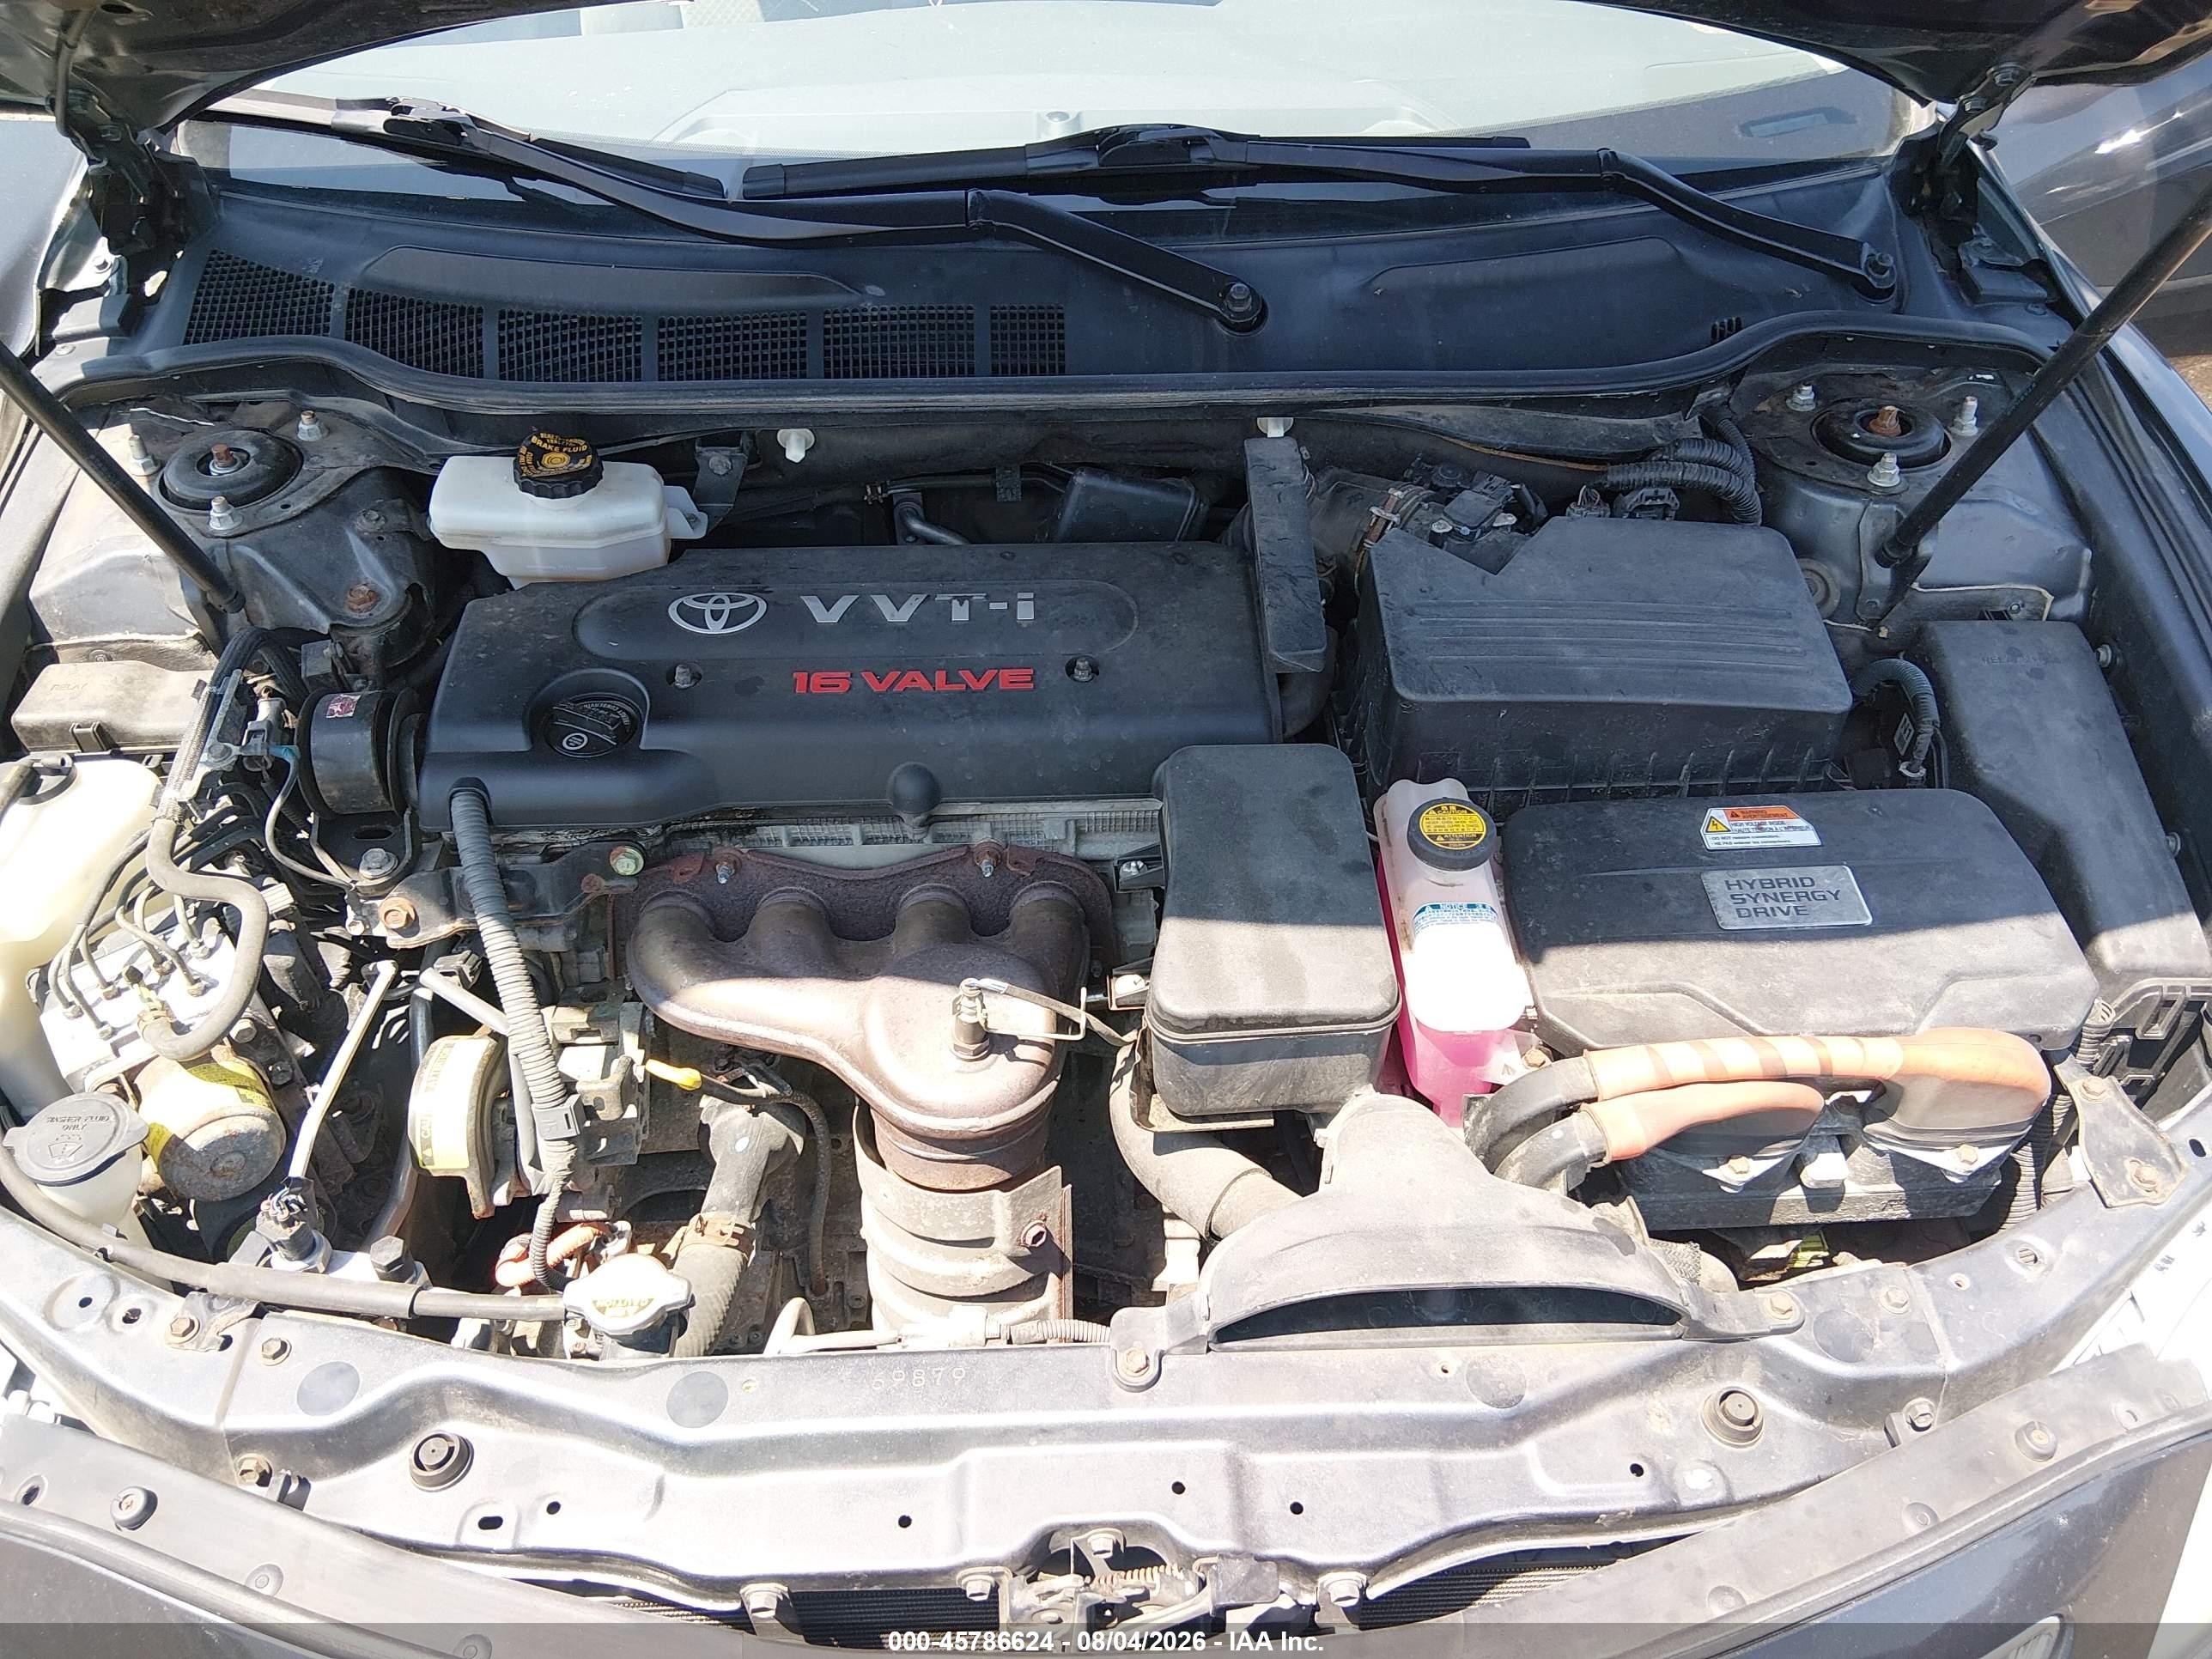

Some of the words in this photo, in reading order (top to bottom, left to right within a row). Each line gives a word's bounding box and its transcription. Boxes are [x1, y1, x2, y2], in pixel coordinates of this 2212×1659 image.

[531, 434, 561, 453] BRAKE
[562, 444, 587, 453] FLUID
[793, 671, 852, 693] 16
[860, 667, 1034, 693] VALVE
[1724, 877, 1815, 890] HYBRID
[1729, 890, 1841, 904] SYNERGY
[1735, 905, 1810, 918] DRIVE
